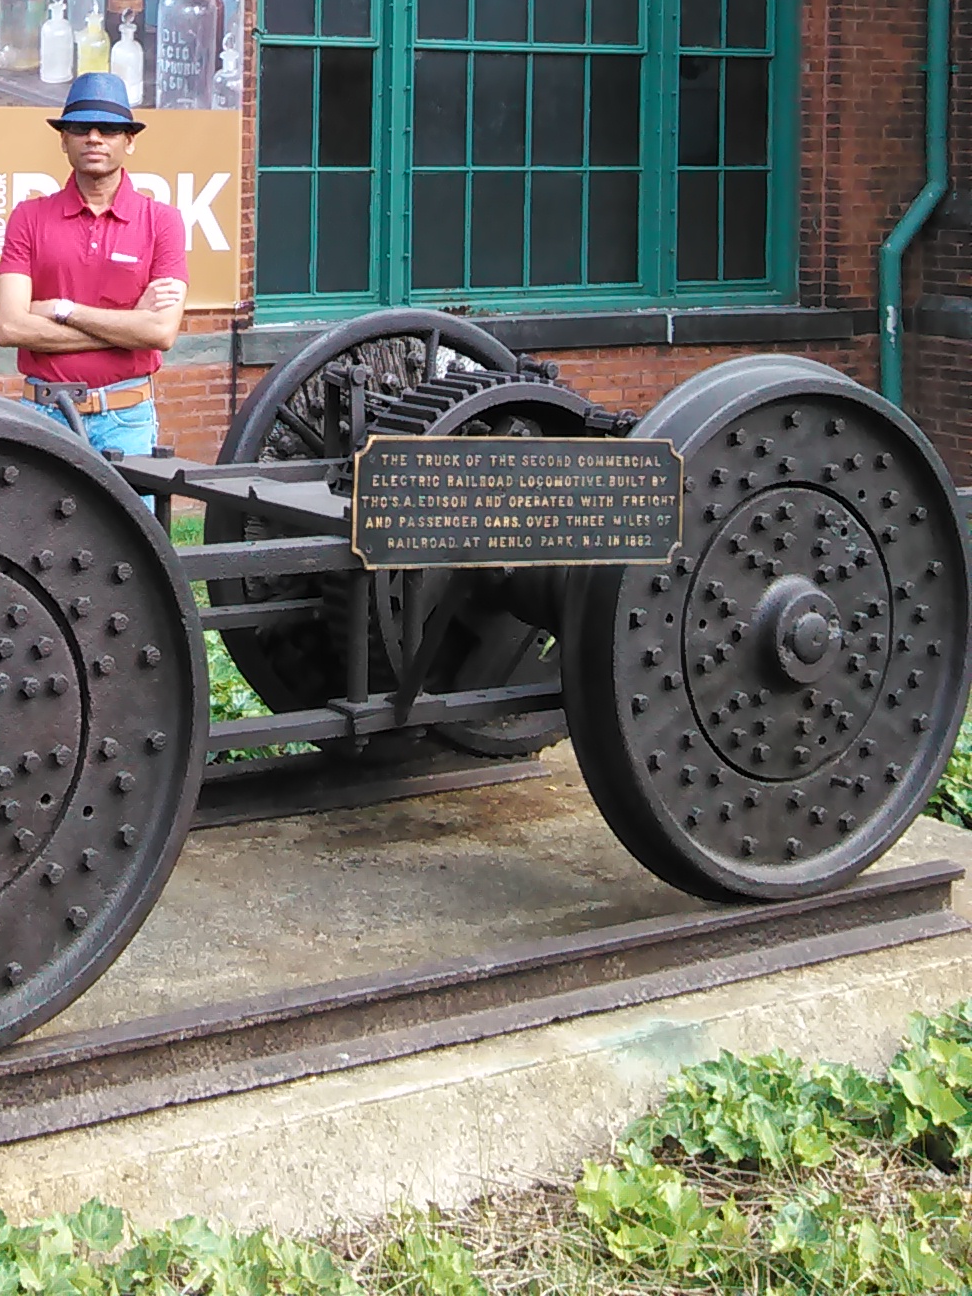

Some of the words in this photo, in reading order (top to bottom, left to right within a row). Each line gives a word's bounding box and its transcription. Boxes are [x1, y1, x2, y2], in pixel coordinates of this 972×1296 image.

[381, 454, 408, 467] THE
[416, 454, 461, 467] TRUCK
[465, 454, 482, 467] OF
[489, 454, 516, 467] THE
[521, 455, 572, 468] SECOND
[577, 455, 662, 469] COMMERCIAL
[371, 474, 440, 487] ELECTRIC
[447, 474, 513, 488] RAILROAD
[608, 475, 646, 488] BUILT
[651, 475, 668, 487] BY
[418, 495, 468, 508] EDISON
[474, 495, 502, 508] AND
[508, 495, 574, 508] OPERATED
[580, 495, 614, 508] WITH
[622, 495, 676, 508] FREIGHT
[365, 516, 392, 529] AND
[399, 516, 478, 529] PASSENGER
[526, 515, 560, 528] OVER
[565, 514, 605, 528] THREE
[612, 514, 650, 527] MILES
[656, 513, 672, 527] OF
[463, 536, 481, 549] AT
[488, 535, 532, 549] MENLO
[608, 535, 620, 548] IN
